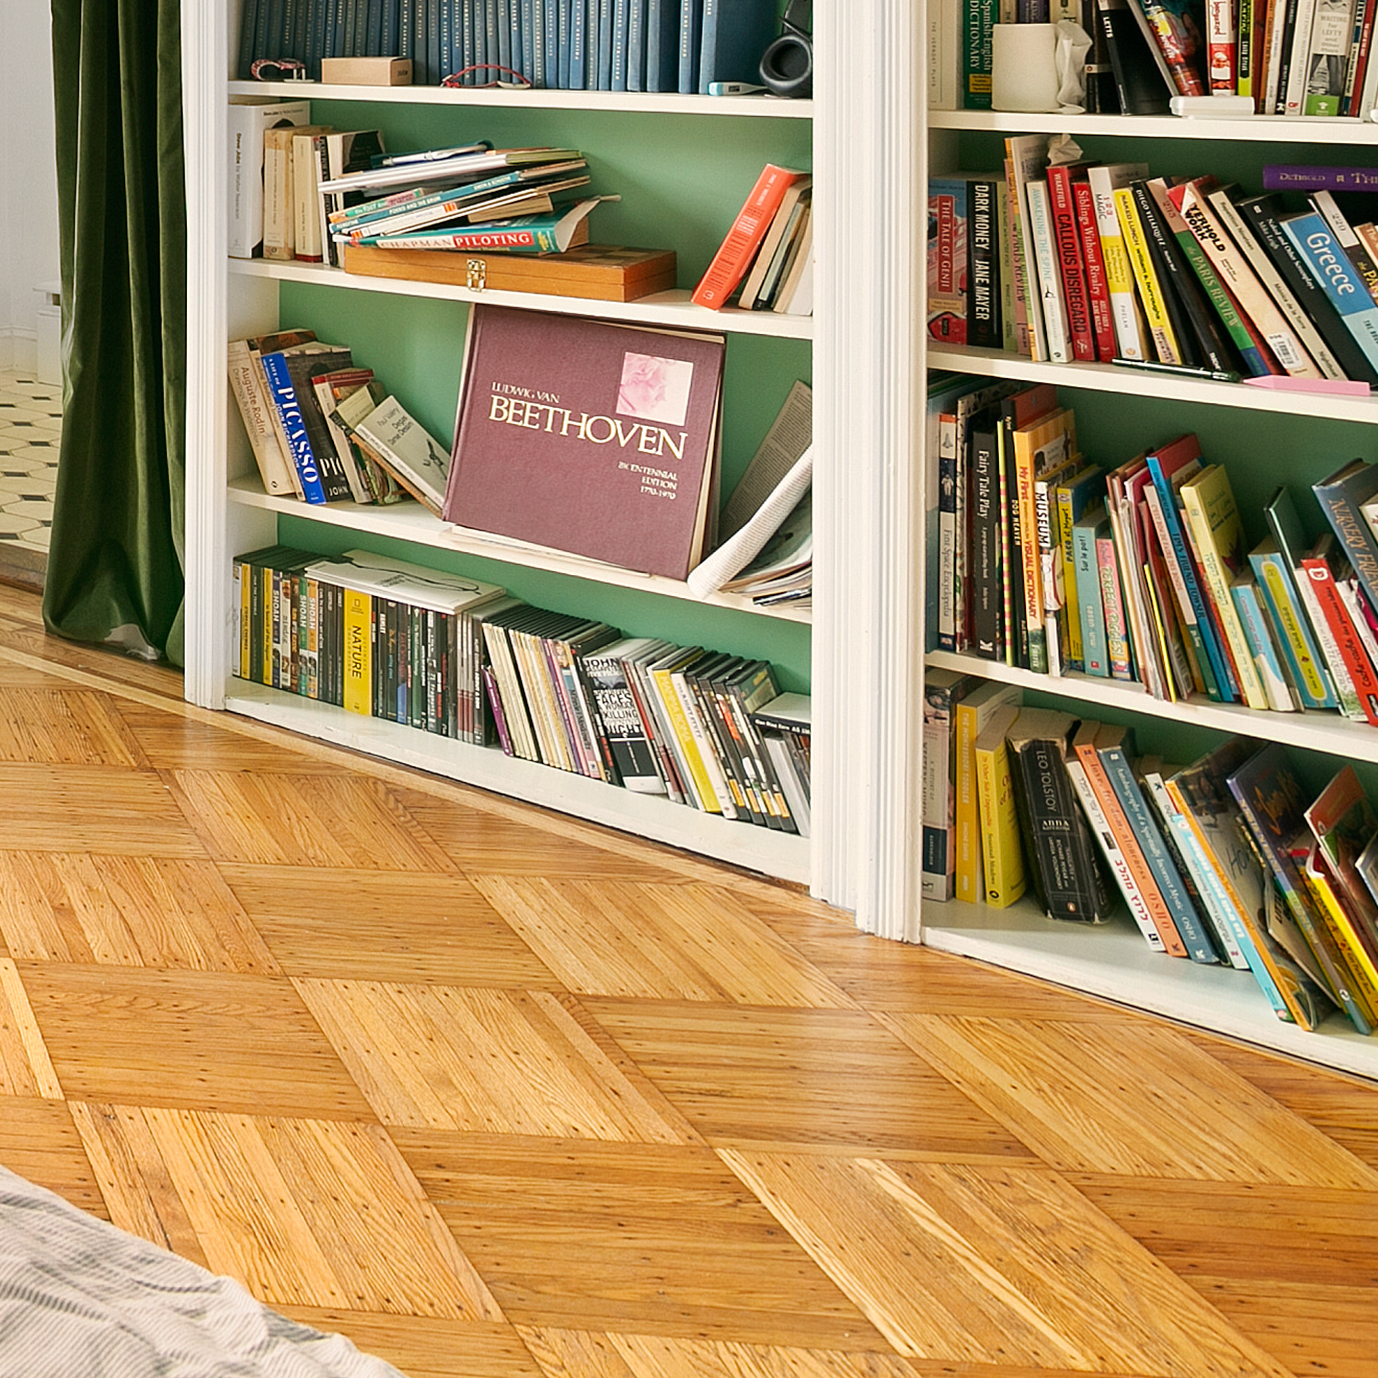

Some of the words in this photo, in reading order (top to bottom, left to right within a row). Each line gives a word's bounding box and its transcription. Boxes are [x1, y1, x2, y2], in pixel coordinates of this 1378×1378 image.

[969, 0, 979, 69] DICTIONARY
[981, 0, 993, 71] Spanish-English
[1103, 17, 1113, 38] LETTS
[975, 185, 989, 212] DARK
[1054, 173, 1066, 208] WAKEFIELD
[942, 200, 951, 221] THE
[1031, 188, 1046, 236] AWAKENING
[1078, 190, 1093, 225] Siblings
[454, 231, 533, 248] PILOTING
[942, 223, 951, 243] TALE
[975, 214, 989, 250] MONEY
[1057, 214, 1078, 266] CALLOUS
[1257, 221, 1270, 236] Mike
[1265, 218, 1279, 234] Naked
[942, 246, 950, 259] OF
[1038, 238, 1048, 254] THE
[1083, 227, 1100, 264] Without
[1263, 236, 1279, 251] Leigh
[1277, 236, 1287, 246] and
[1281, 246, 1297, 261] Other
[975, 259, 989, 284] JANE
[1041, 256, 1051, 281] SPINE
[1121, 194, 1133, 220] NAKED
[1127, 221, 1139, 246] LUNCH
[1136, 248, 1150, 274] william
[1144, 281, 1161, 320] burroughs
[1306, 232, 1356, 296] Greece
[942, 261, 952, 288] GENJI
[1087, 265, 1102, 295] Rivalry
[1292, 261, 1316, 290] Screenplays
[976, 286, 989, 320] MAYER
[1066, 268, 1086, 333] DISREGARD
[1194, 256, 1220, 288] PARIS
[1210, 288, 1240, 328] REVIEW
[241, 366, 259, 405] Auguste
[251, 407, 266, 433] Rodin
[537, 390, 560, 403] VAN
[278, 386, 318, 483] PICASSO
[489, 395, 688, 459] BEETHOVEN
[978, 450, 989, 475] Fairy
[1019, 466, 1029, 480] My
[640, 486, 676, 499] 1770-1970
[642, 477, 677, 489] EDITION
[979, 477, 989, 494] Tale
[1020, 481, 1031, 500] First
[978, 495, 990, 519] Play
[1011, 499, 1020, 516] DOG
[1035, 492, 1050, 545] MUSEUM
[943, 529, 952, 545] First
[1012, 517, 1021, 546] HEAVEN
[1171, 532, 1187, 555] TIM'S
[942, 547, 952, 569] Space
[1024, 540, 1034, 569] VISUAL
[1178, 556, 1196, 585] FRIEND
[942, 570, 954, 617] Encyclopedia
[1026, 570, 1037, 619] DICTIONARY
[1101, 566, 1117, 611] PERFECT
[1188, 586, 1206, 619] TOWSER
[299, 595, 307, 627] SHOAH
[308, 597, 316, 629] SHOAH
[1106, 613, 1123, 656] PIGGIES!
[351, 625, 361, 678] NATURE
[660, 676, 679, 711] MAMMA
[672, 713, 692, 742] ROMA
[1036, 750, 1048, 770] LEO
[962, 772, 970, 804] TODDLER
[1040, 772, 1057, 812] TOLSTOY
[1116, 767, 1138, 812] Autobiography
[1090, 763, 1103, 786] love,
[1103, 790, 1122, 832] freedom,
[1122, 834, 1148, 882] aloneness
[1180, 916, 1197, 940] OSHO
[1140, 825, 1168, 858] Spiritually
[1156, 858, 1177, 887] Incorrect
[1148, 892, 1171, 930] OSHO
[1167, 888, 1184, 911] Mystic
